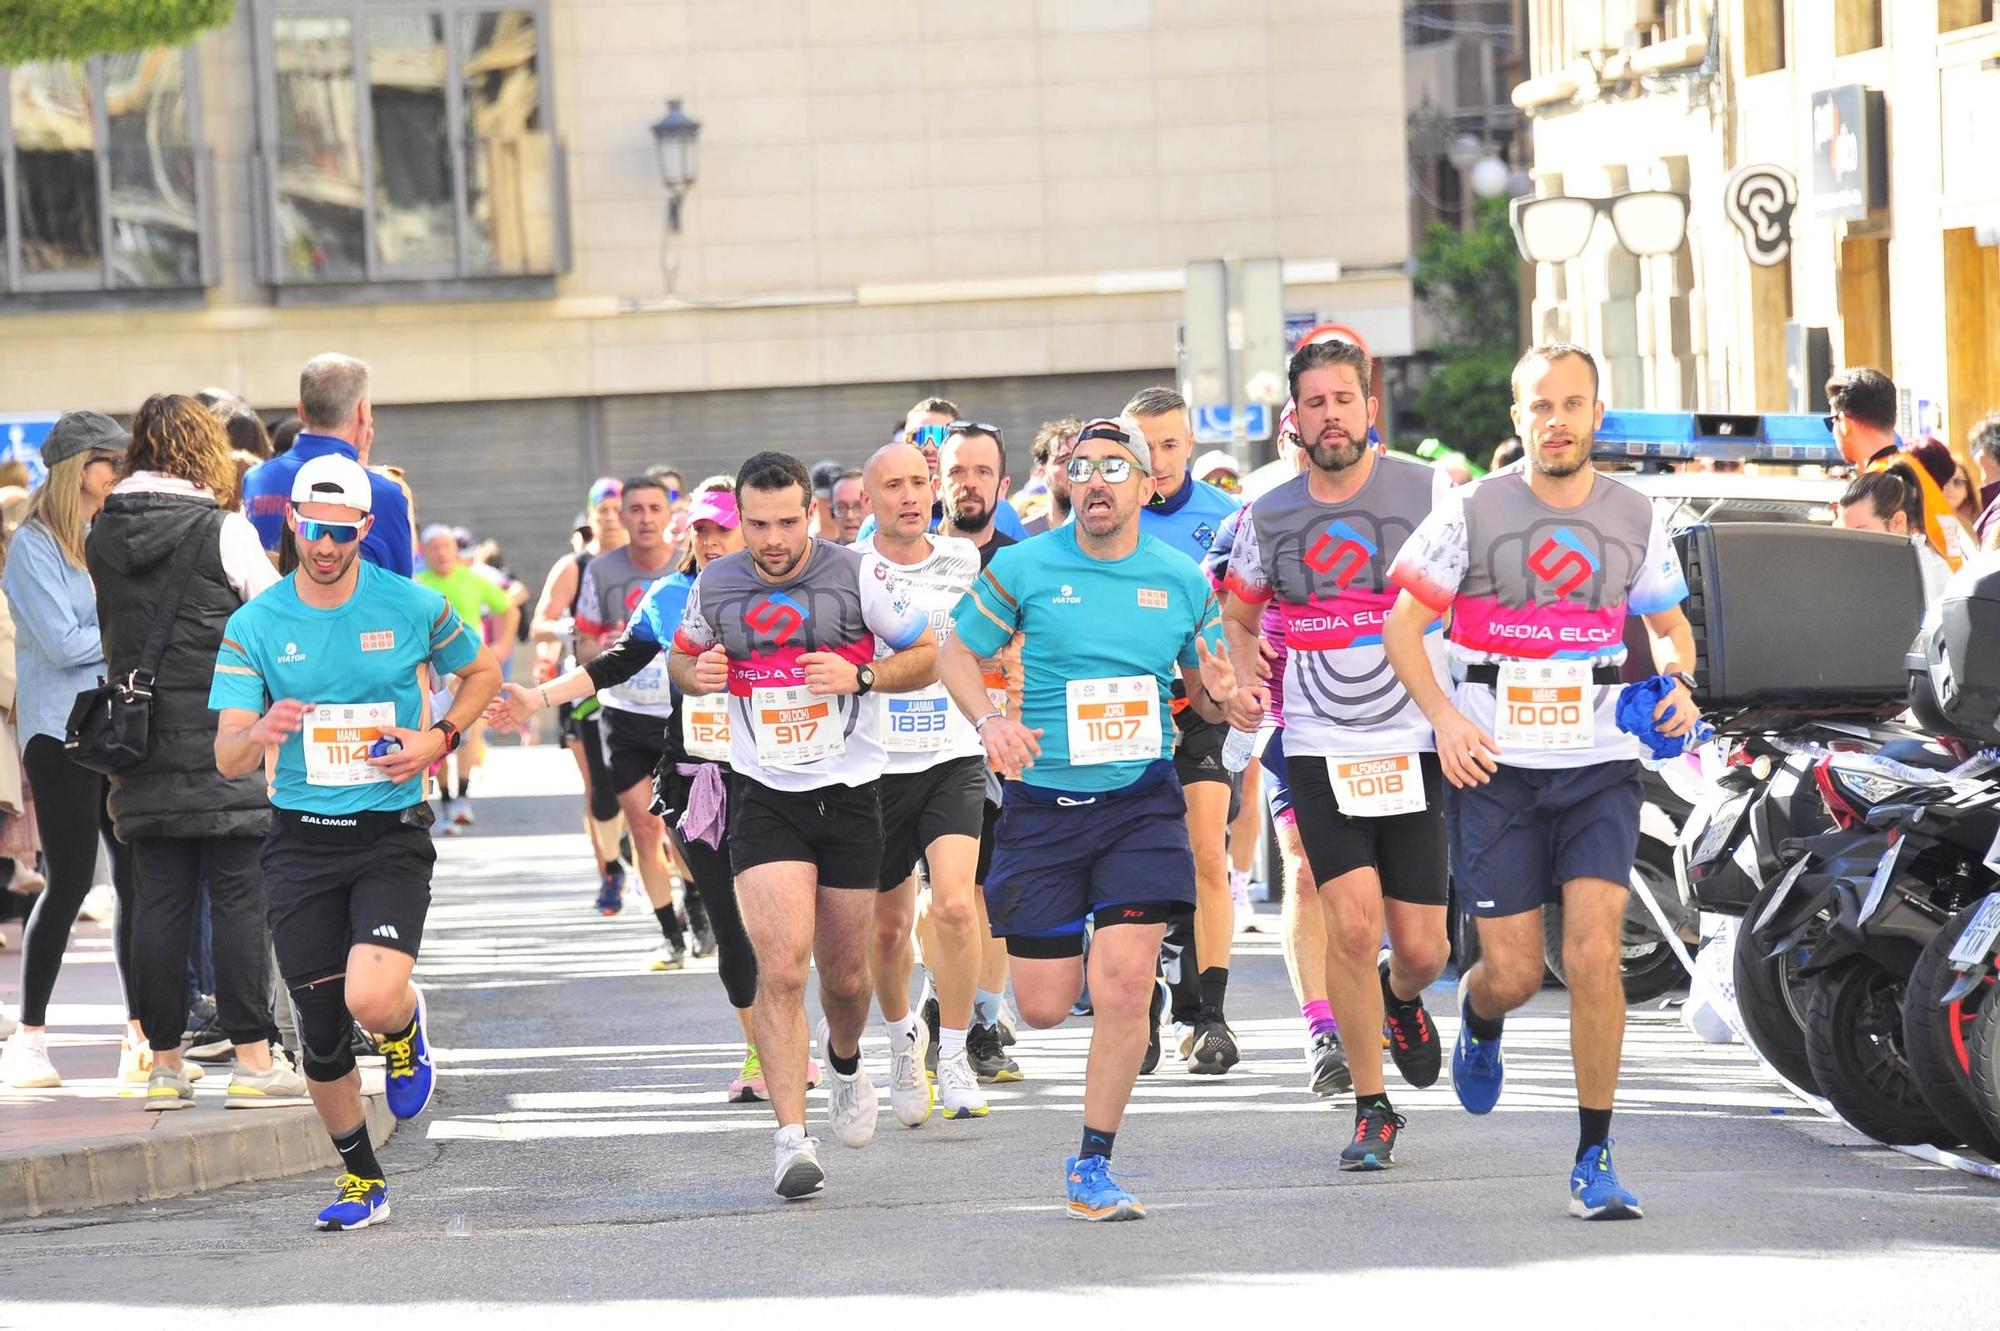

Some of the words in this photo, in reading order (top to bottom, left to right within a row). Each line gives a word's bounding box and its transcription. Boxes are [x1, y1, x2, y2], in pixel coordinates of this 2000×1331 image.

[1288, 616, 1348, 632] MEDIA
[1489, 621, 1553, 640] MEDIA
[277, 653, 306, 663] VIATOR
[779, 711, 792, 723] OKI
[792, 709, 810, 721] DOKI
[891, 714, 946, 732] 1833
[1508, 704, 1580, 725] 1000
[775, 722, 818, 744] 917
[1087, 720, 1141, 741] 1107
[327, 745, 369, 765] 1114
[1347, 774, 1404, 797] 1018
[301, 815, 357, 826] SALOMON
